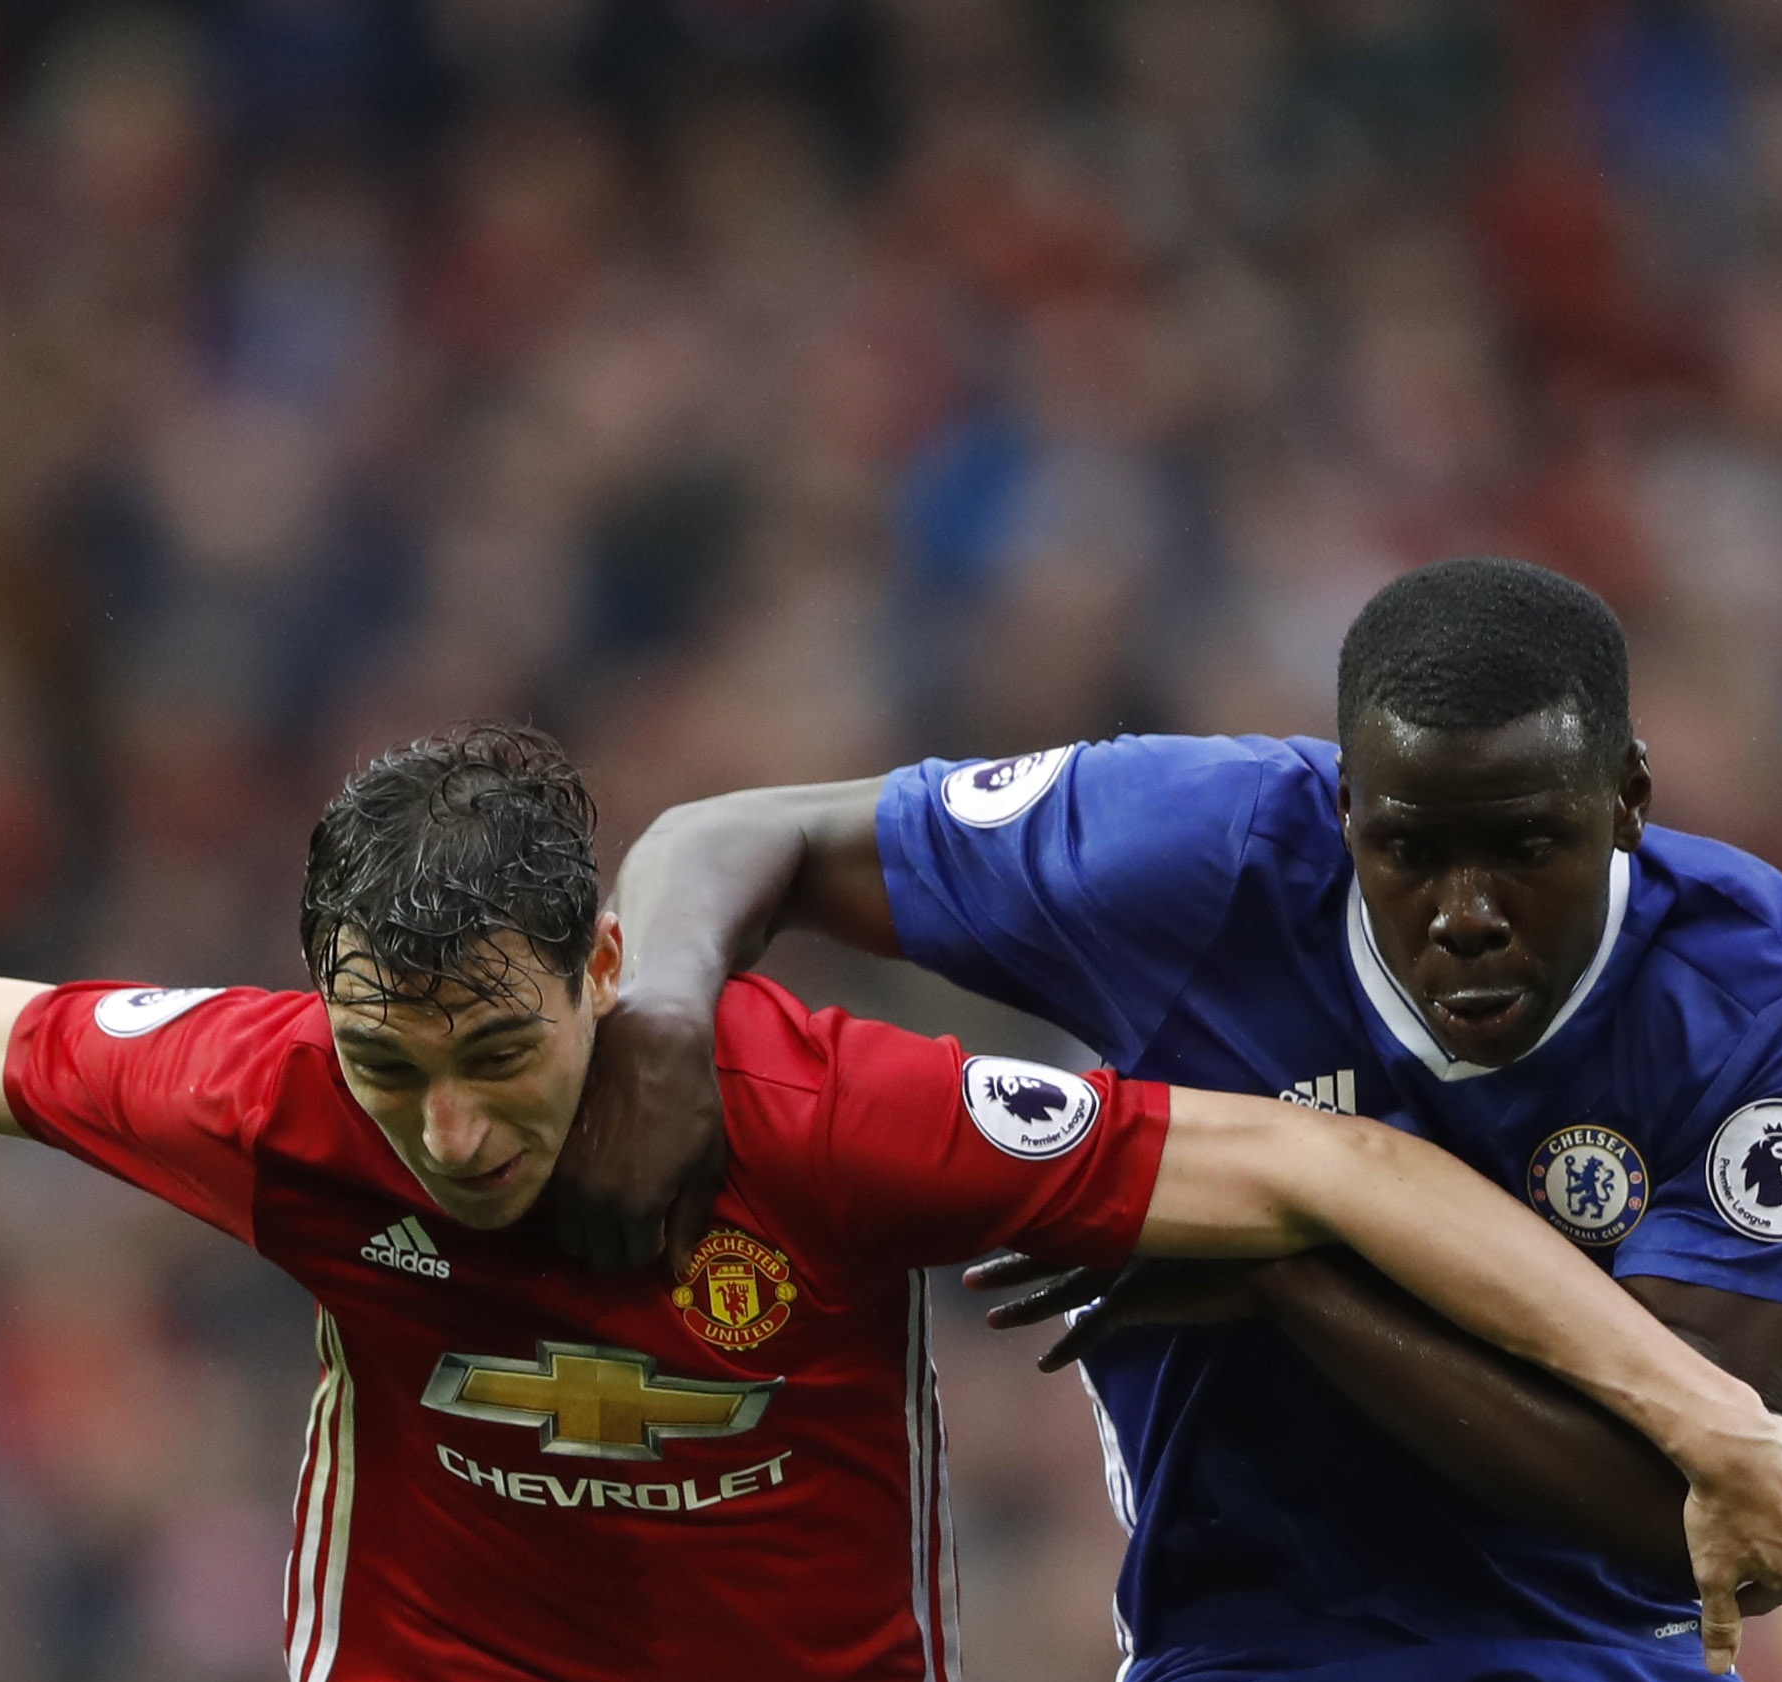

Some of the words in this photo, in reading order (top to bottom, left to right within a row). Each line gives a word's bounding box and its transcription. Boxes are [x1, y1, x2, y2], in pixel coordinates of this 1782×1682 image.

[1020, 1131, 1062, 1146] Premier
[1548, 1130, 1628, 1159] CHELSEA
[1718, 1157, 1735, 1201] Premier
[1732, 1199, 1772, 1228] League
[1601, 1221, 1626, 1239] CLUB
[360, 1246, 451, 1279] adidas
[686, 1238, 780, 1277] MANCHESTER
[705, 1319, 774, 1343] UNITED
[436, 1443, 792, 1511] CHEVROLET
[1654, 1620, 1698, 1639] adizero
